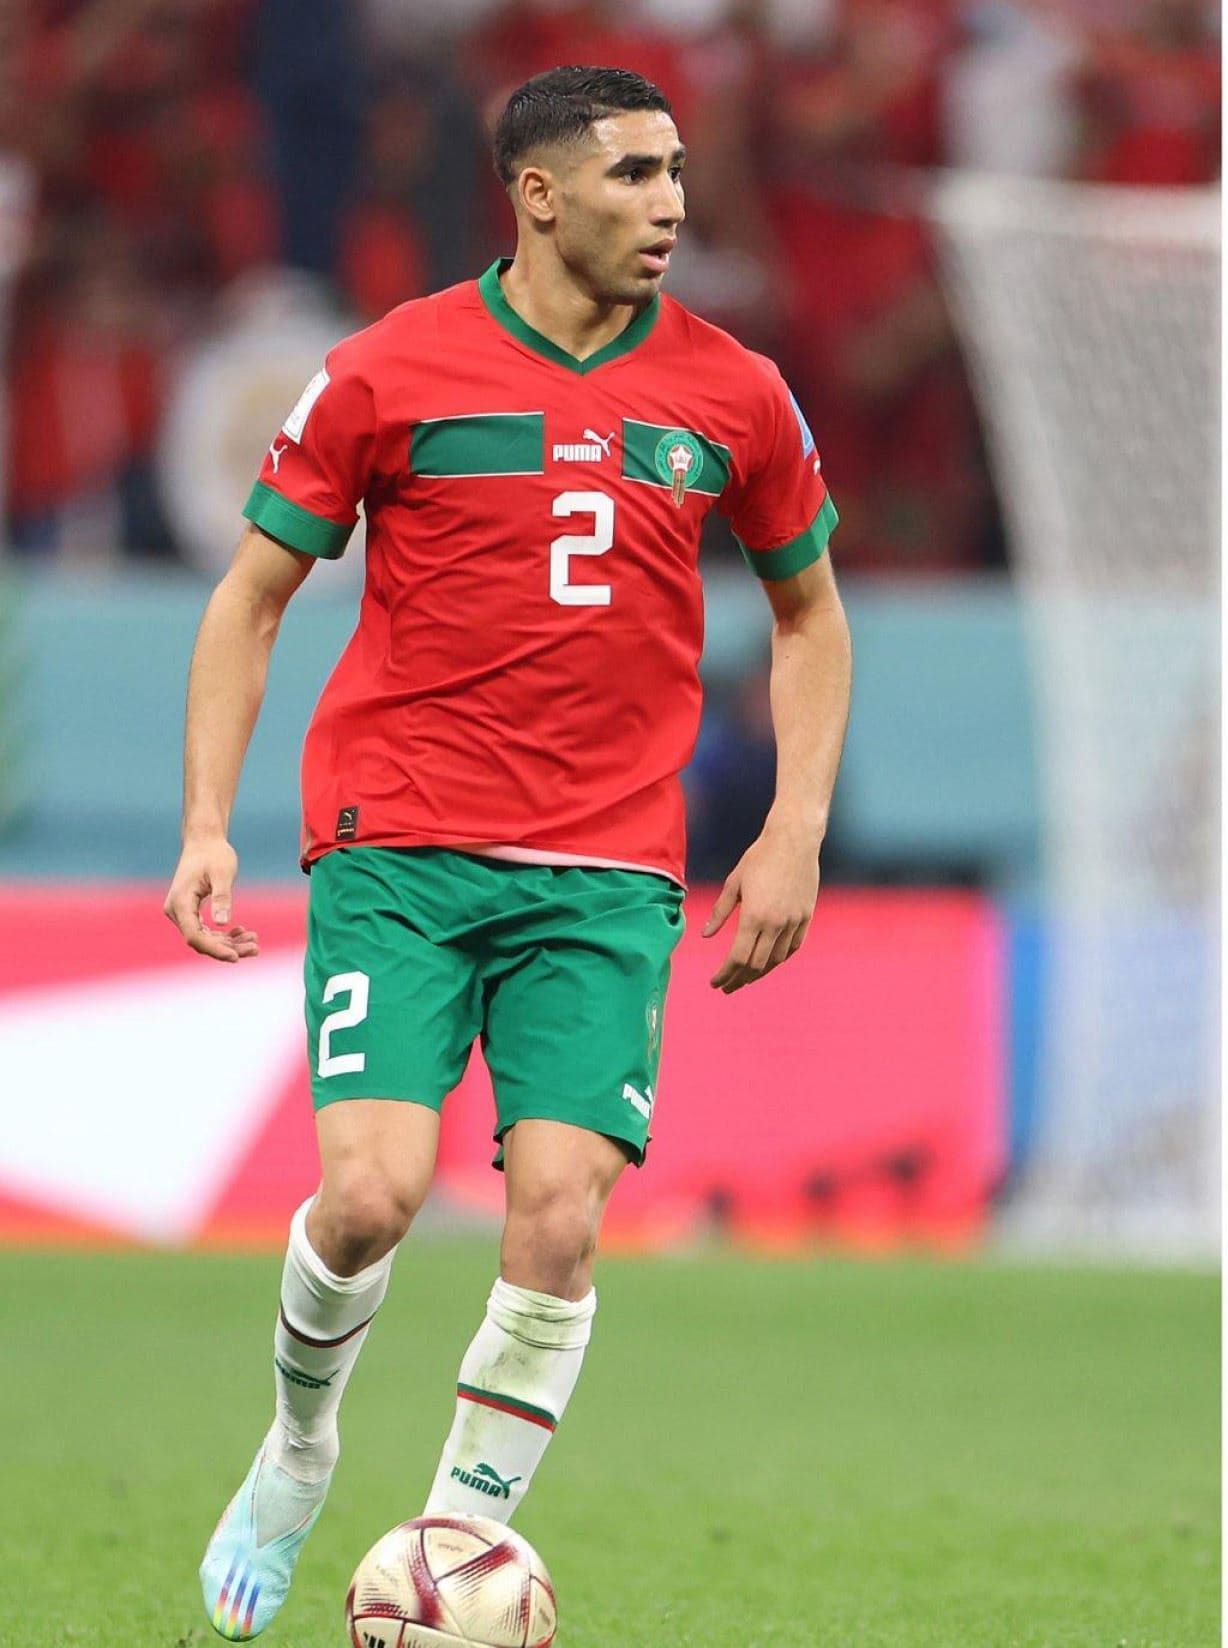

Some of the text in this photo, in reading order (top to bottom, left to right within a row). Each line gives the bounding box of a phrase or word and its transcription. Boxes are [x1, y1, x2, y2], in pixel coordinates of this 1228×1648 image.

[552, 444, 602, 463] PUMA
[550, 491, 615, 606] 2
[317, 971, 369, 1079] 2
[450, 1466, 502, 1498] PUMA
